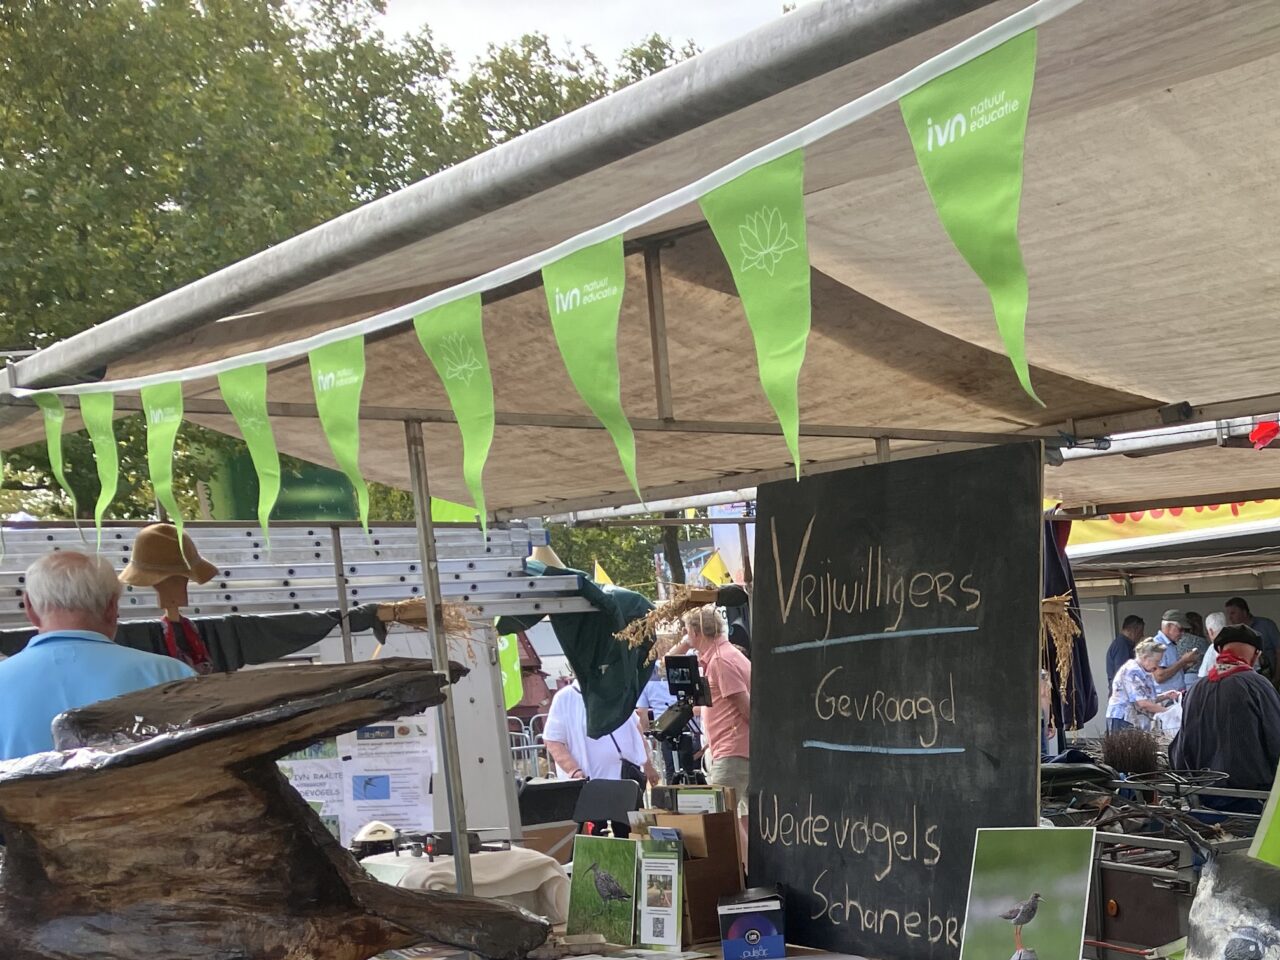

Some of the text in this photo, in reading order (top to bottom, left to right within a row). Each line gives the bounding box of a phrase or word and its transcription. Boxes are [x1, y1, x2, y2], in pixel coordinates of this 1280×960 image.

[970, 89, 1006, 118] natuur
[927, 99, 1020, 152] ivn educatie
[555, 287, 580, 316] ivn
